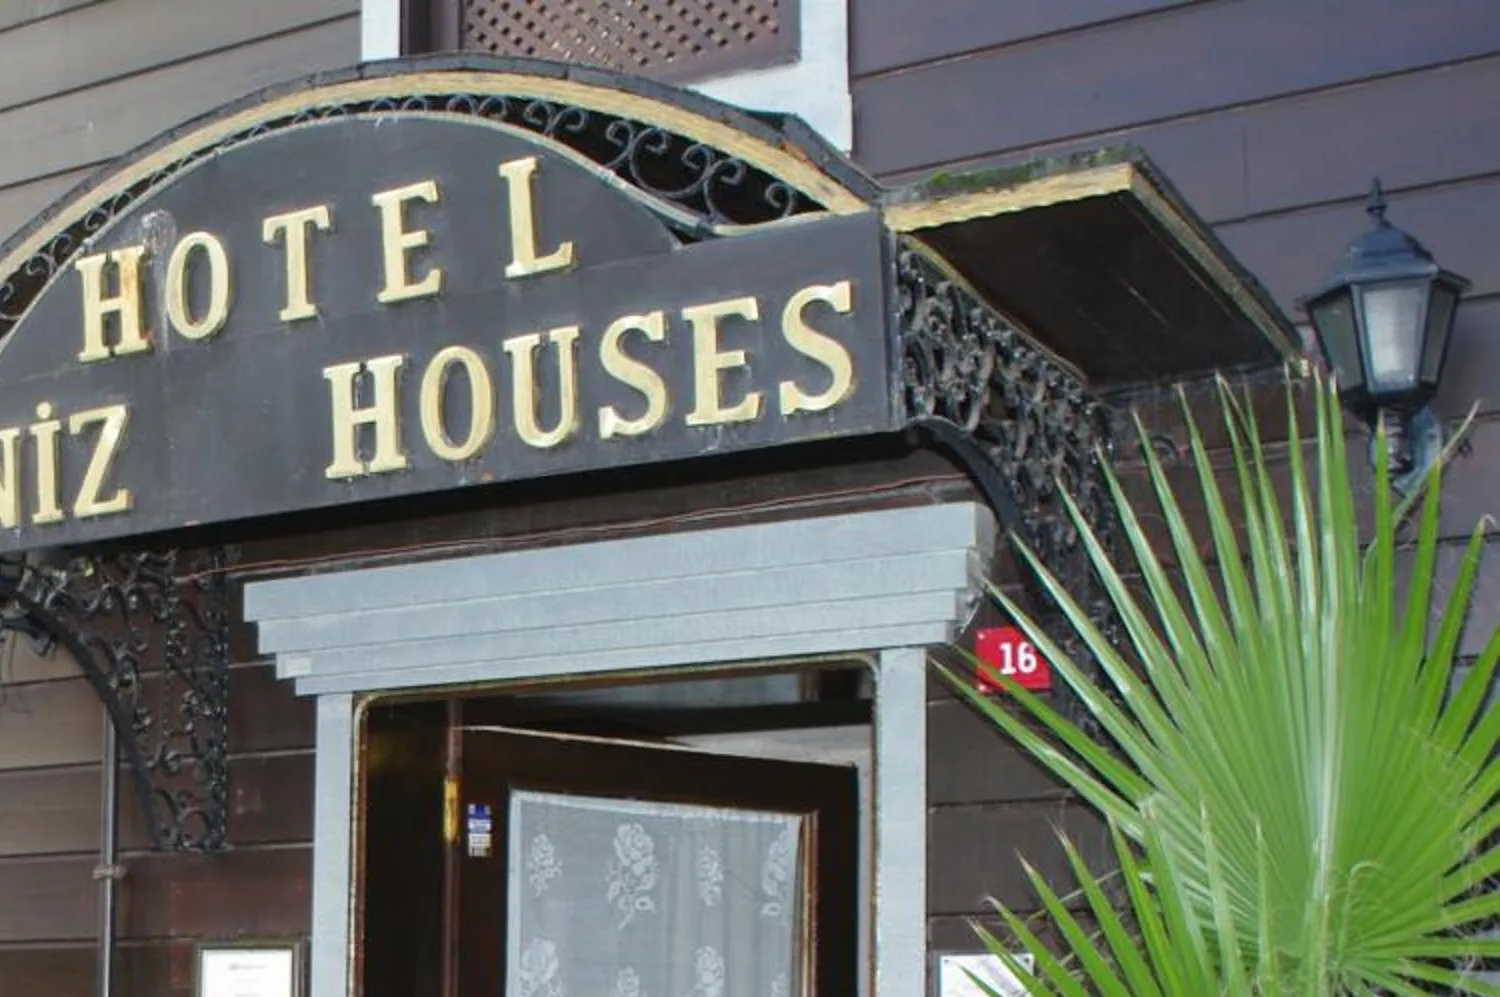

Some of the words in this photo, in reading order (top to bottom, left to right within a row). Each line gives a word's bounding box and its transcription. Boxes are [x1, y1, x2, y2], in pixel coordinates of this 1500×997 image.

[75, 156, 576, 362] HOTEL
[323, 280, 855, 480] HOUSES
[999, 641, 1038, 675] 16
